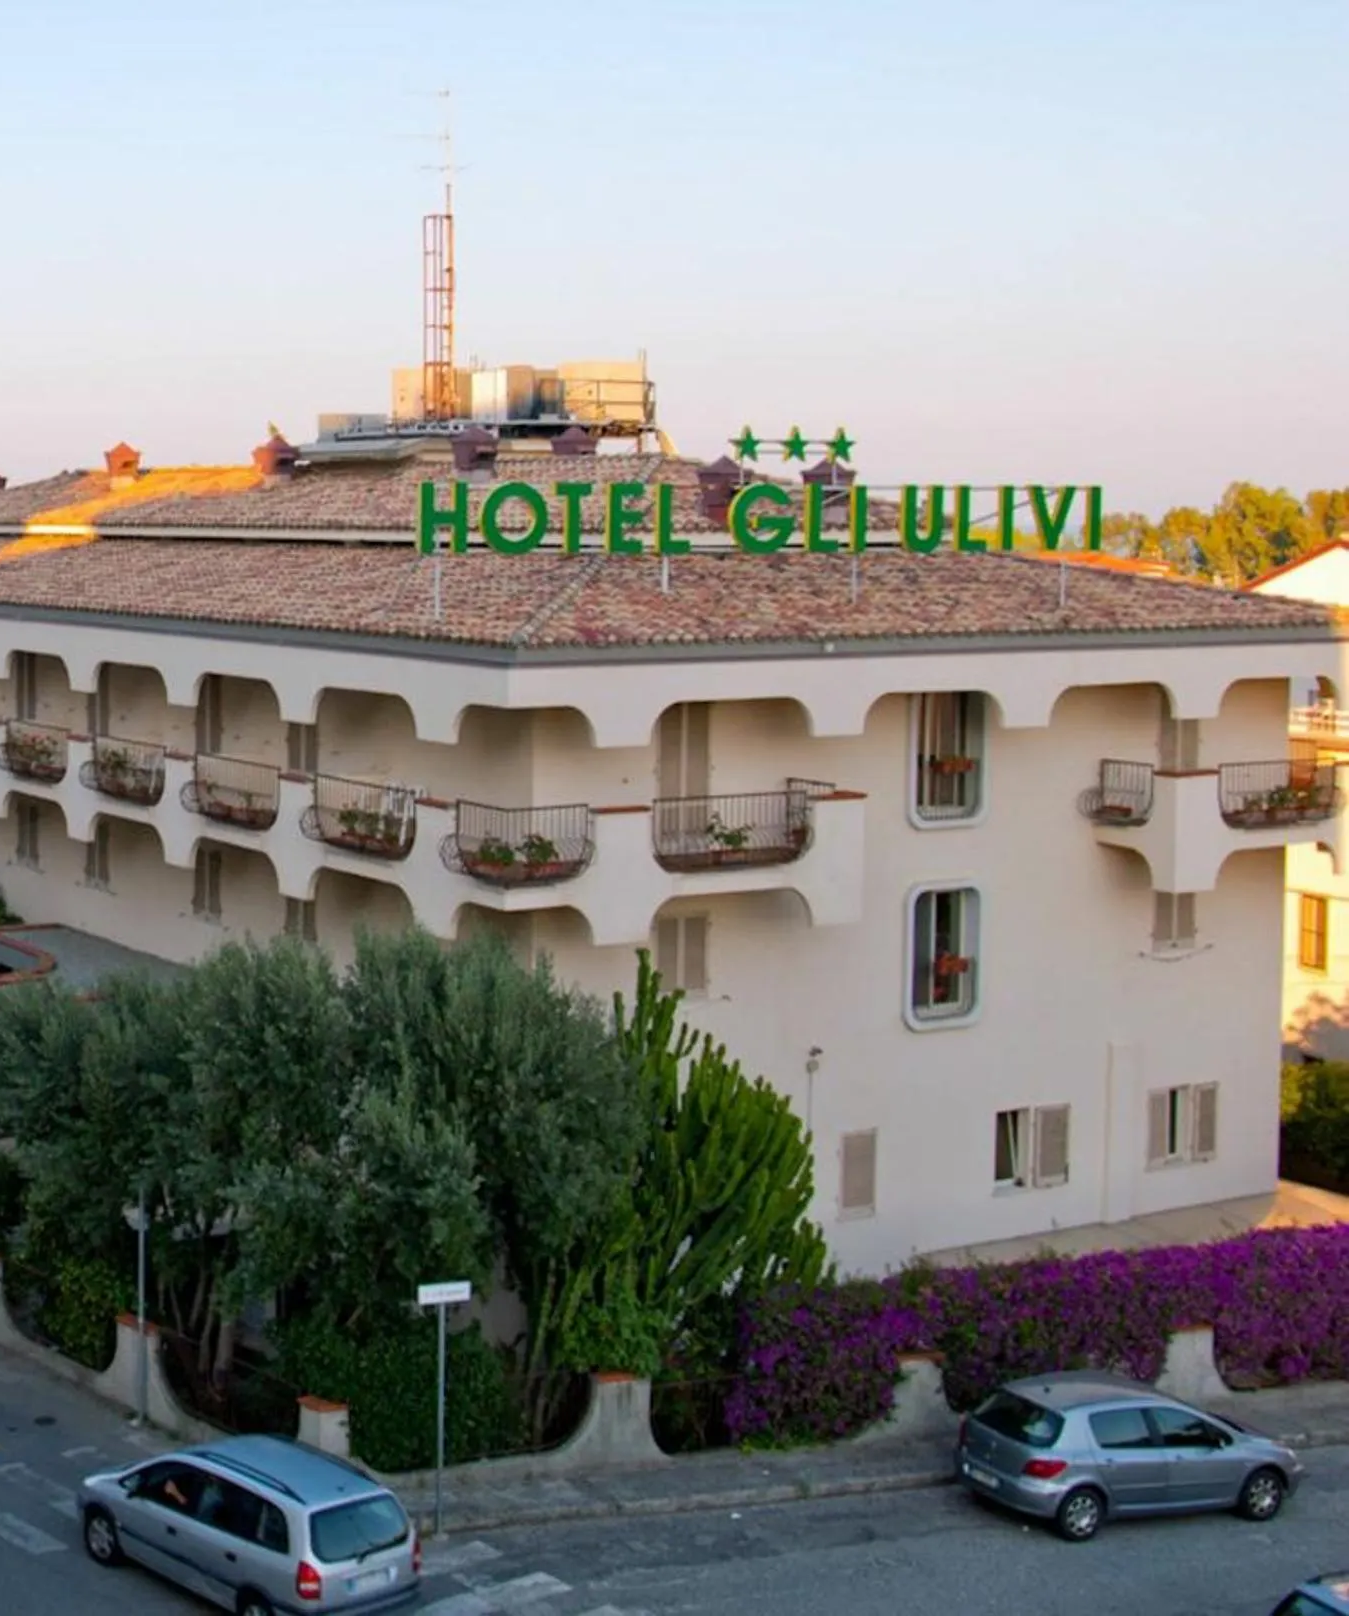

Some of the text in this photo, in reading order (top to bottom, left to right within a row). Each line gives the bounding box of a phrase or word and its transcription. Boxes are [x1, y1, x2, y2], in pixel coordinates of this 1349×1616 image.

[419, 481, 1102, 555] HOTEL GLI ULIVI
